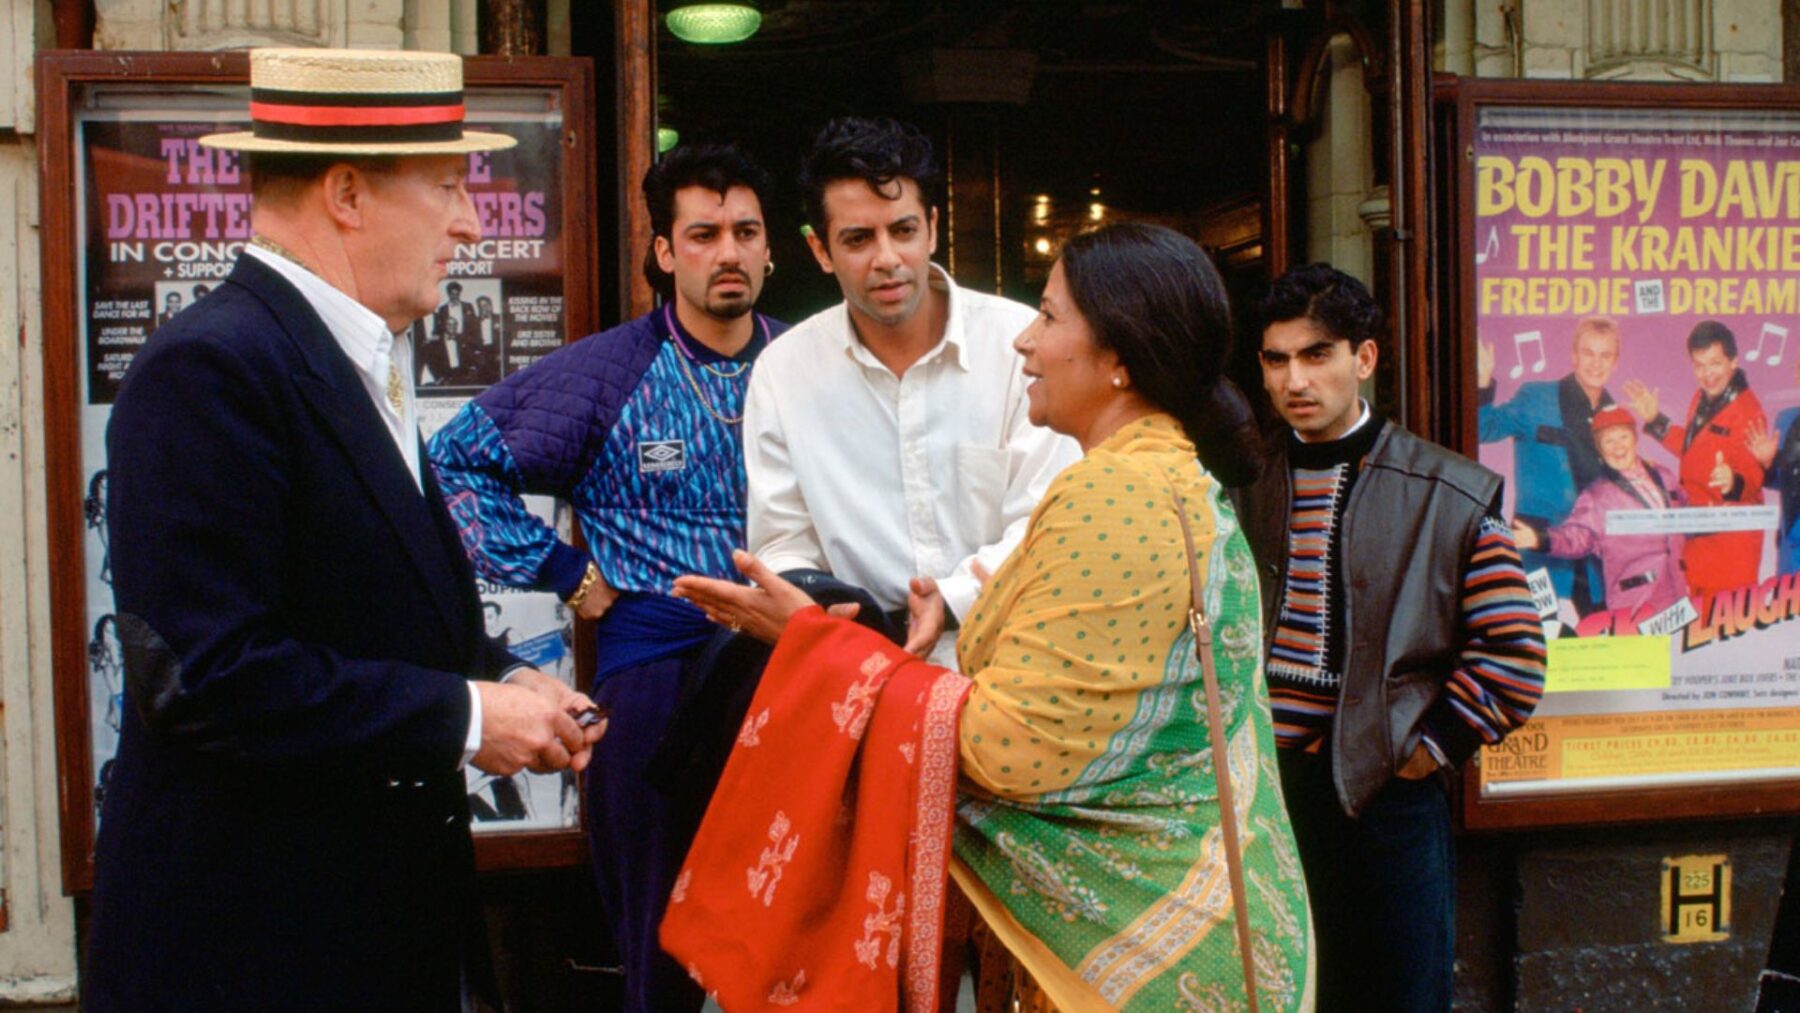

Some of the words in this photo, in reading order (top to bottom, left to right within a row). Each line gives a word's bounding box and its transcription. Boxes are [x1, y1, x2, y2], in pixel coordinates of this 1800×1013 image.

[161, 138, 241, 184] THE
[464, 151, 491, 183] E
[1477, 156, 1667, 223] BOBBY
[107, 192, 254, 239] DRIFTE
[470, 191, 546, 237] ERS
[111, 242, 144, 262] IN
[1511, 224, 1595, 271] THE
[1611, 225, 1800, 272] KRANKIE
[1481, 277, 1632, 316] FREDDIE
[1639, 284, 1661, 298] AND
[1641, 296, 1661, 310] THE
[1669, 277, 1800, 316] DREAM
[1487, 754, 1549, 770] THEATRE
[1670, 864, 1722, 935] H
[1685, 908, 1708, 928] 16
